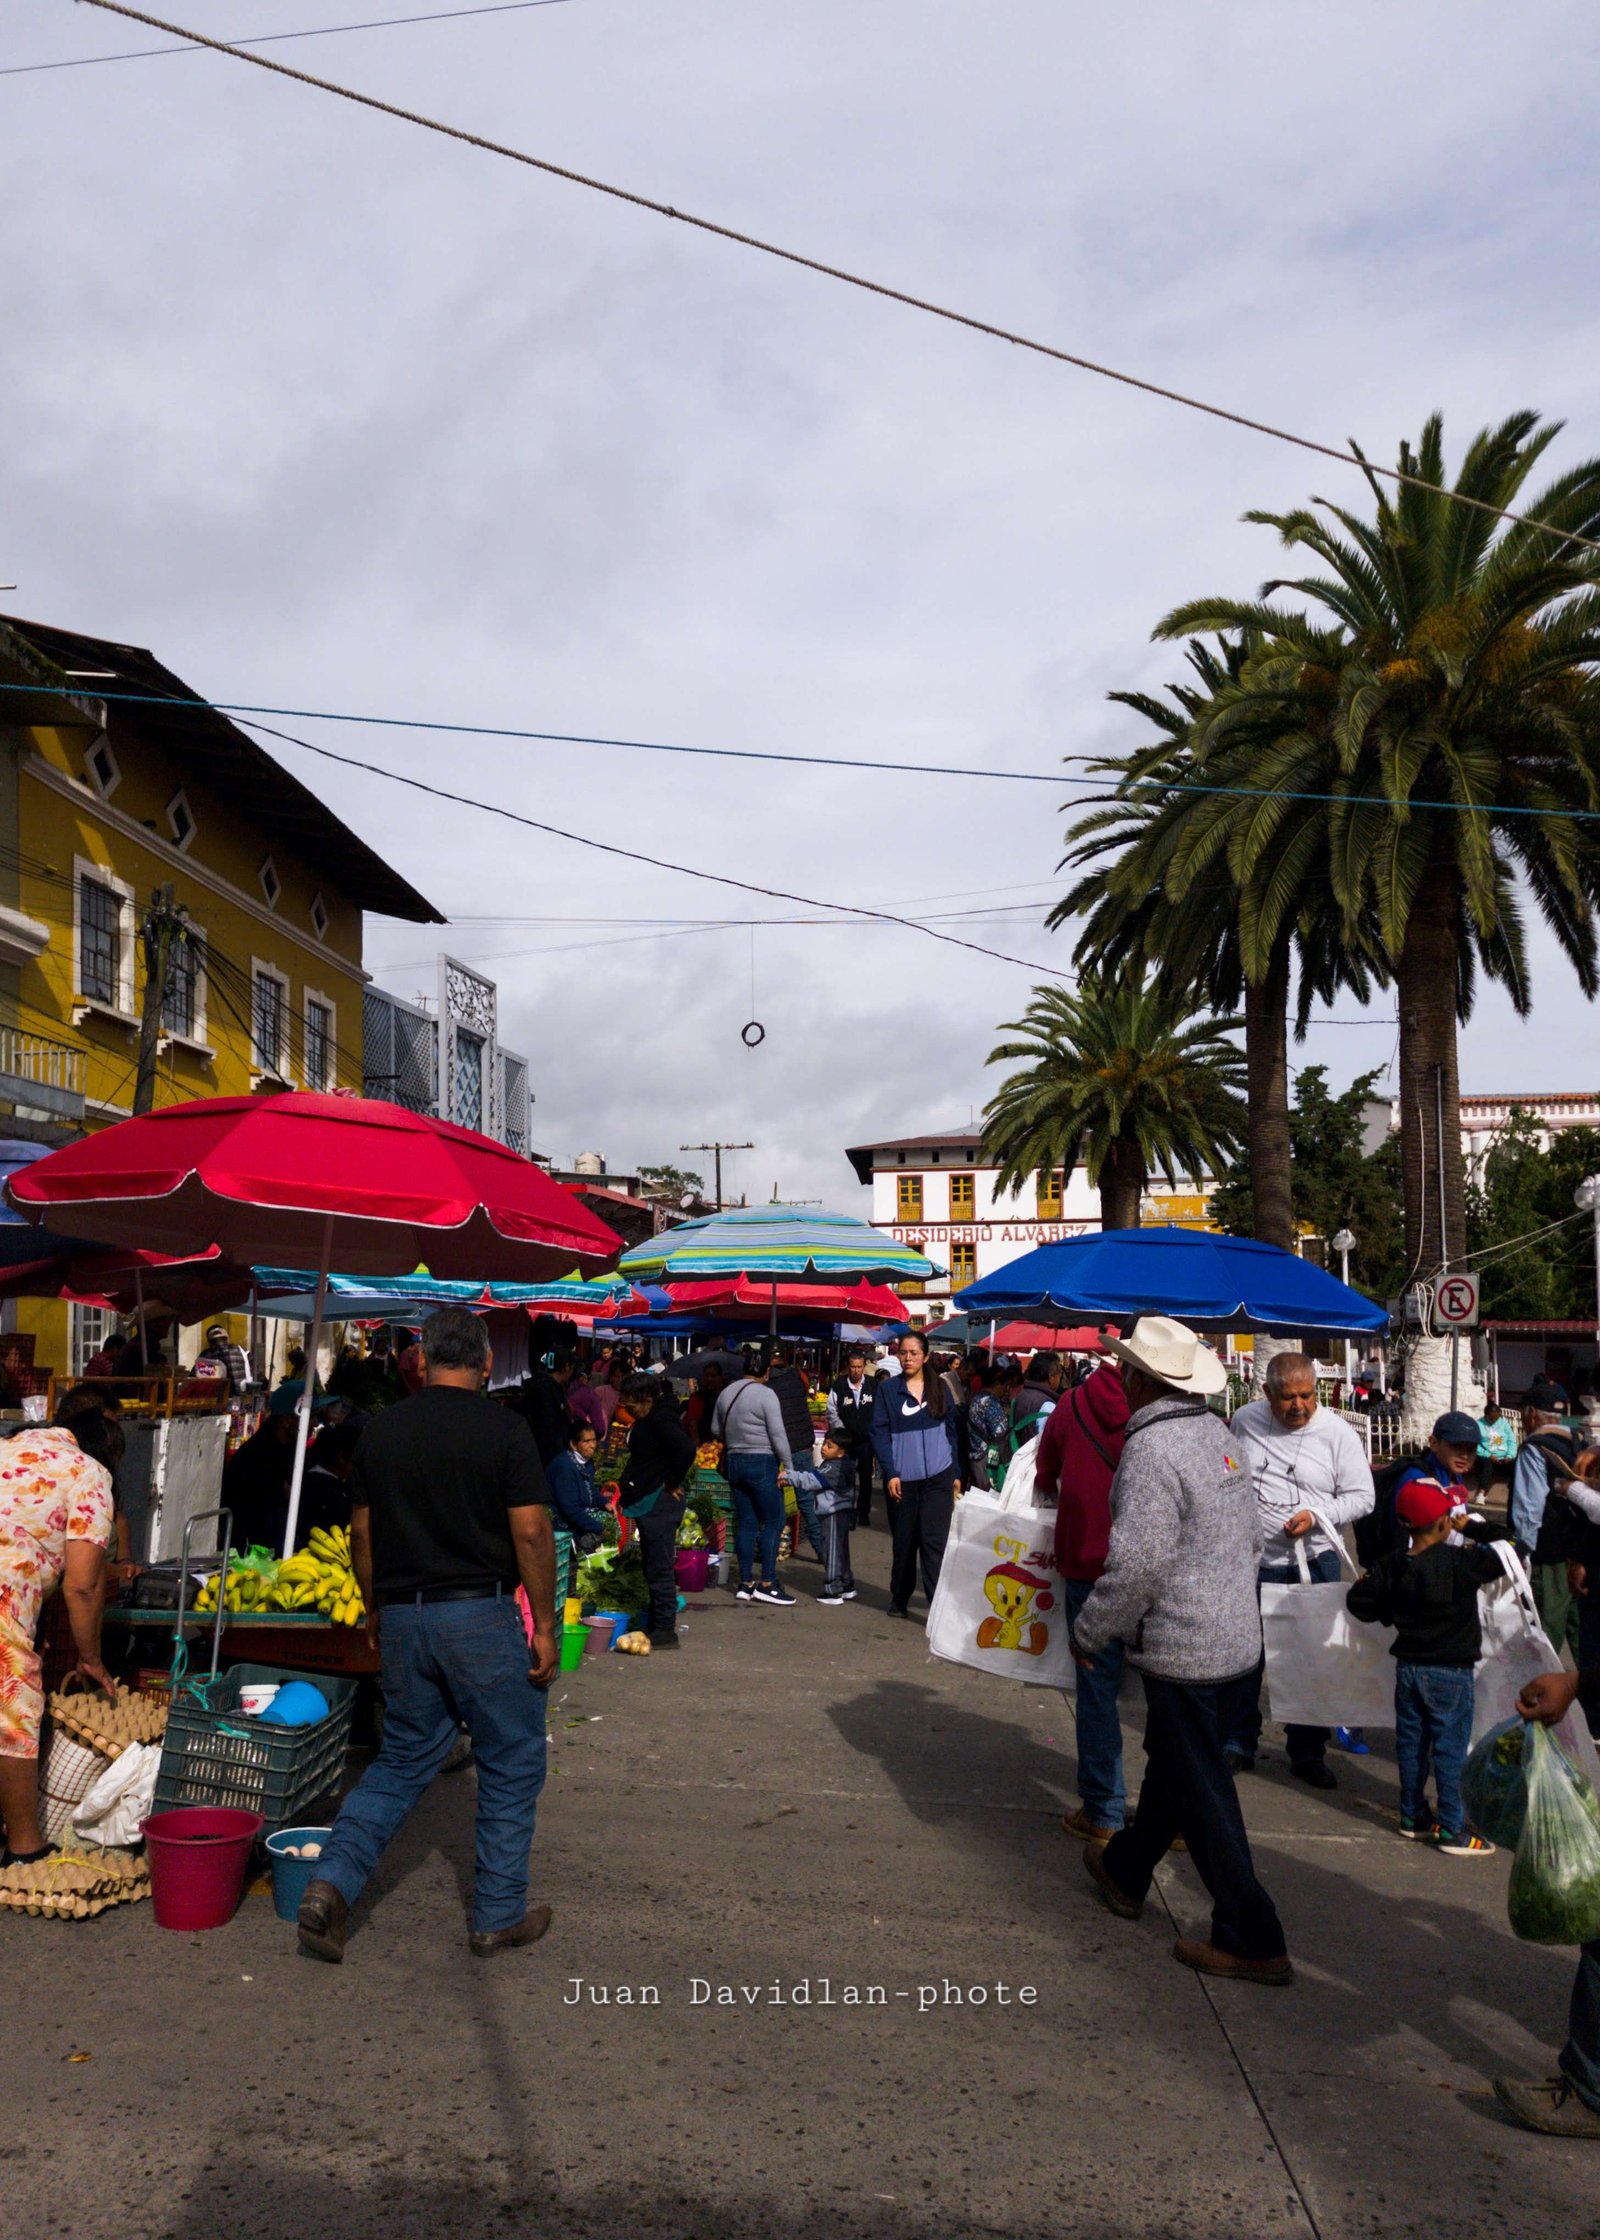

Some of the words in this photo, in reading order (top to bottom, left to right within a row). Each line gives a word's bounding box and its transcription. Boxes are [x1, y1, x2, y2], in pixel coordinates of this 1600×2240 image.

[893, 1227, 993, 1243] DESIDERIO
[1001, 1225, 1088, 1242] ALVAREZ
[993, 1535, 1029, 1564] CT
